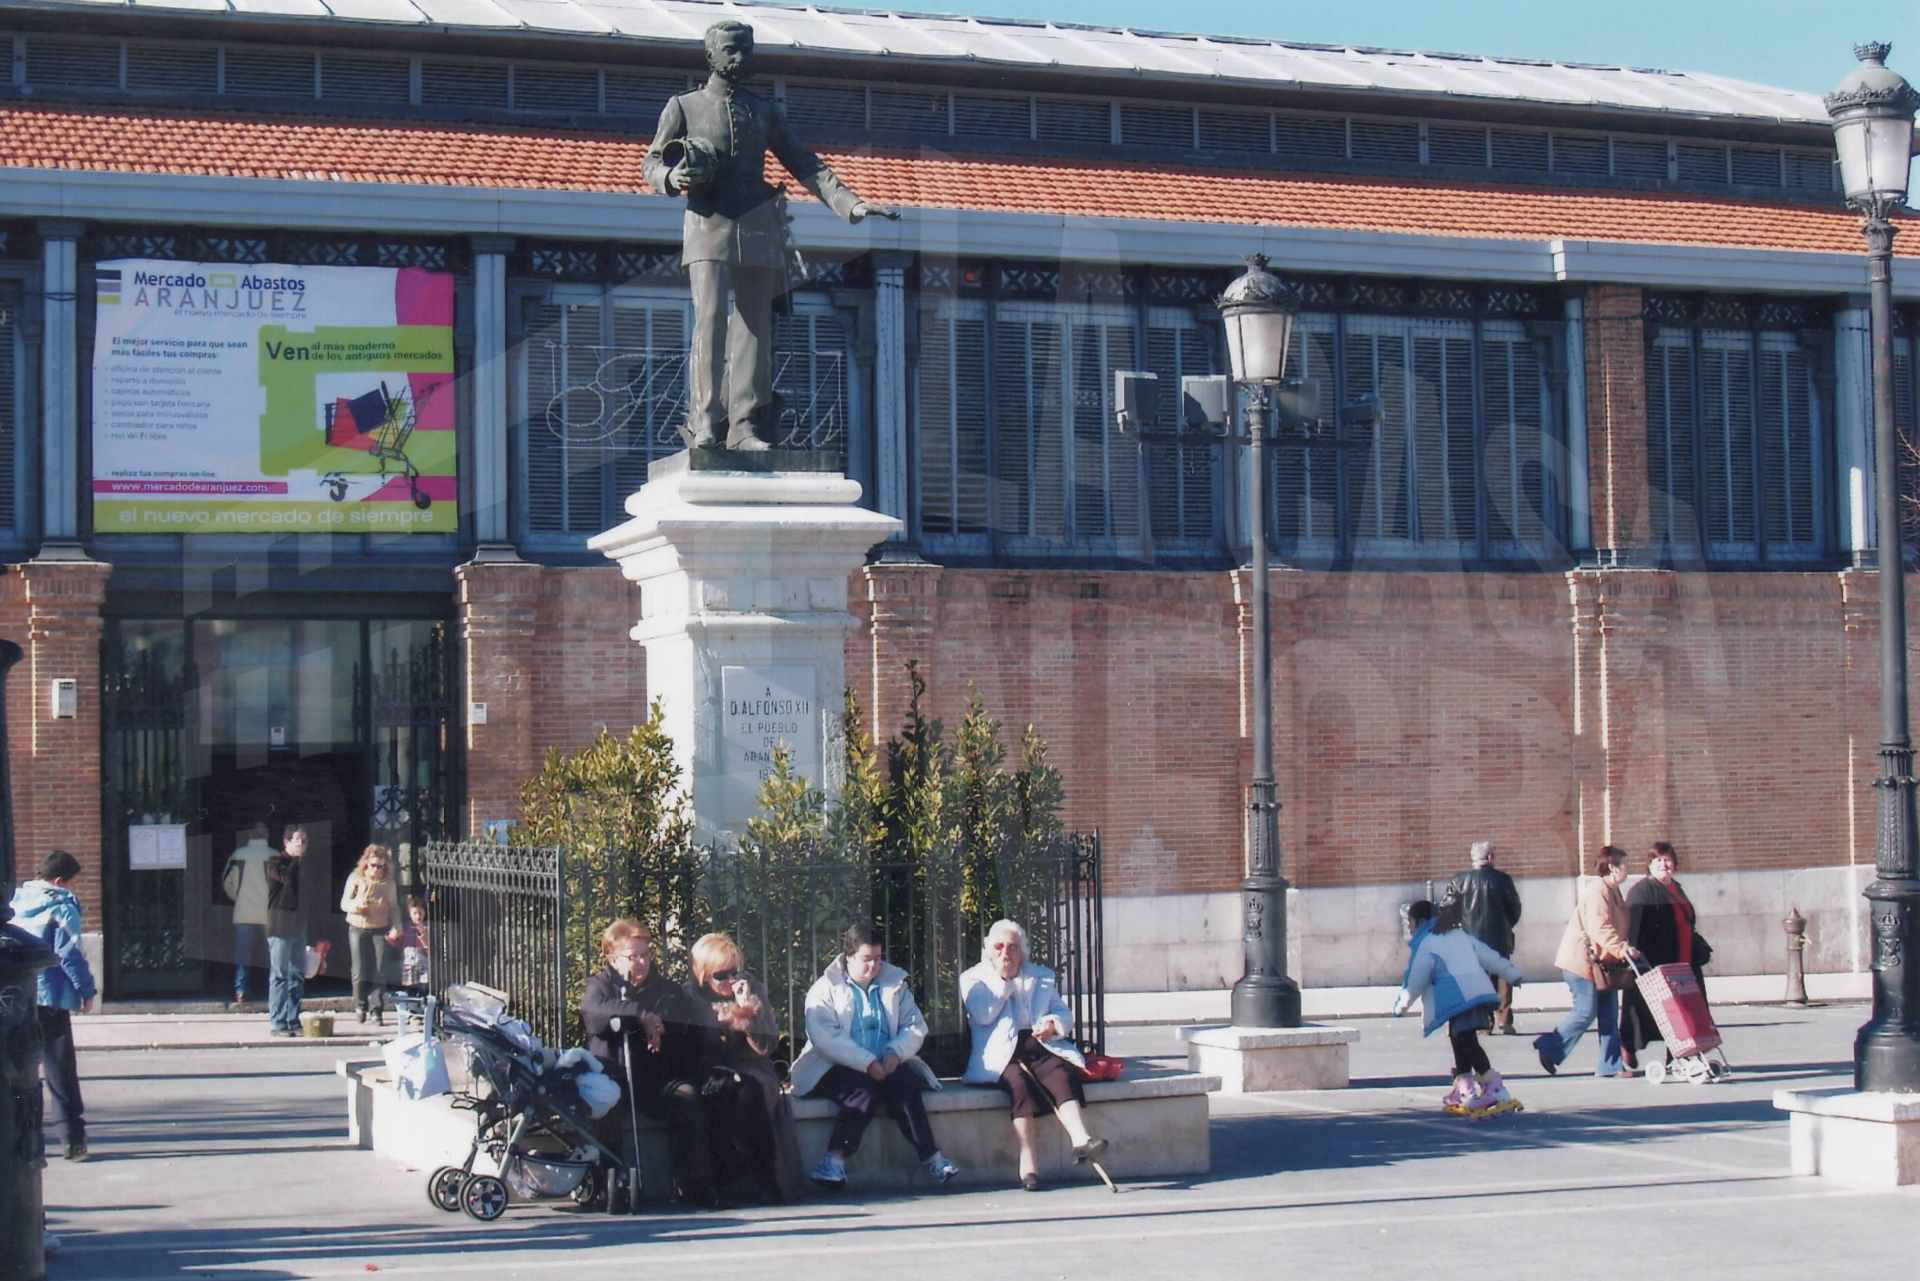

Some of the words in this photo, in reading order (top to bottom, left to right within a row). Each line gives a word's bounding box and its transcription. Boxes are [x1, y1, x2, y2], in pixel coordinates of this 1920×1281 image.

[134, 271, 206, 288] Mercado
[241, 275, 306, 291] Abastos
[134, 288, 306, 311] ARANJUEZ
[122, 337, 148, 347] mejor
[150, 338, 184, 347] servicio
[186, 339, 207, 349] para
[209, 341, 224, 350] que
[265, 340, 310, 360] Ven
[326, 351, 343, 361] los
[393, 351, 443, 361] mercados
[111, 481, 269, 494] www.mercadodearanjuez.com
[118, 507, 137, 524] el
[143, 510, 210, 524] nuevo
[215, 507, 313, 525] mercado
[317, 508, 345, 525] de
[350, 508, 434, 527] siempre
[741, 700, 793, 716] ALFONSO
[757, 722, 799, 734] PUEBLO
